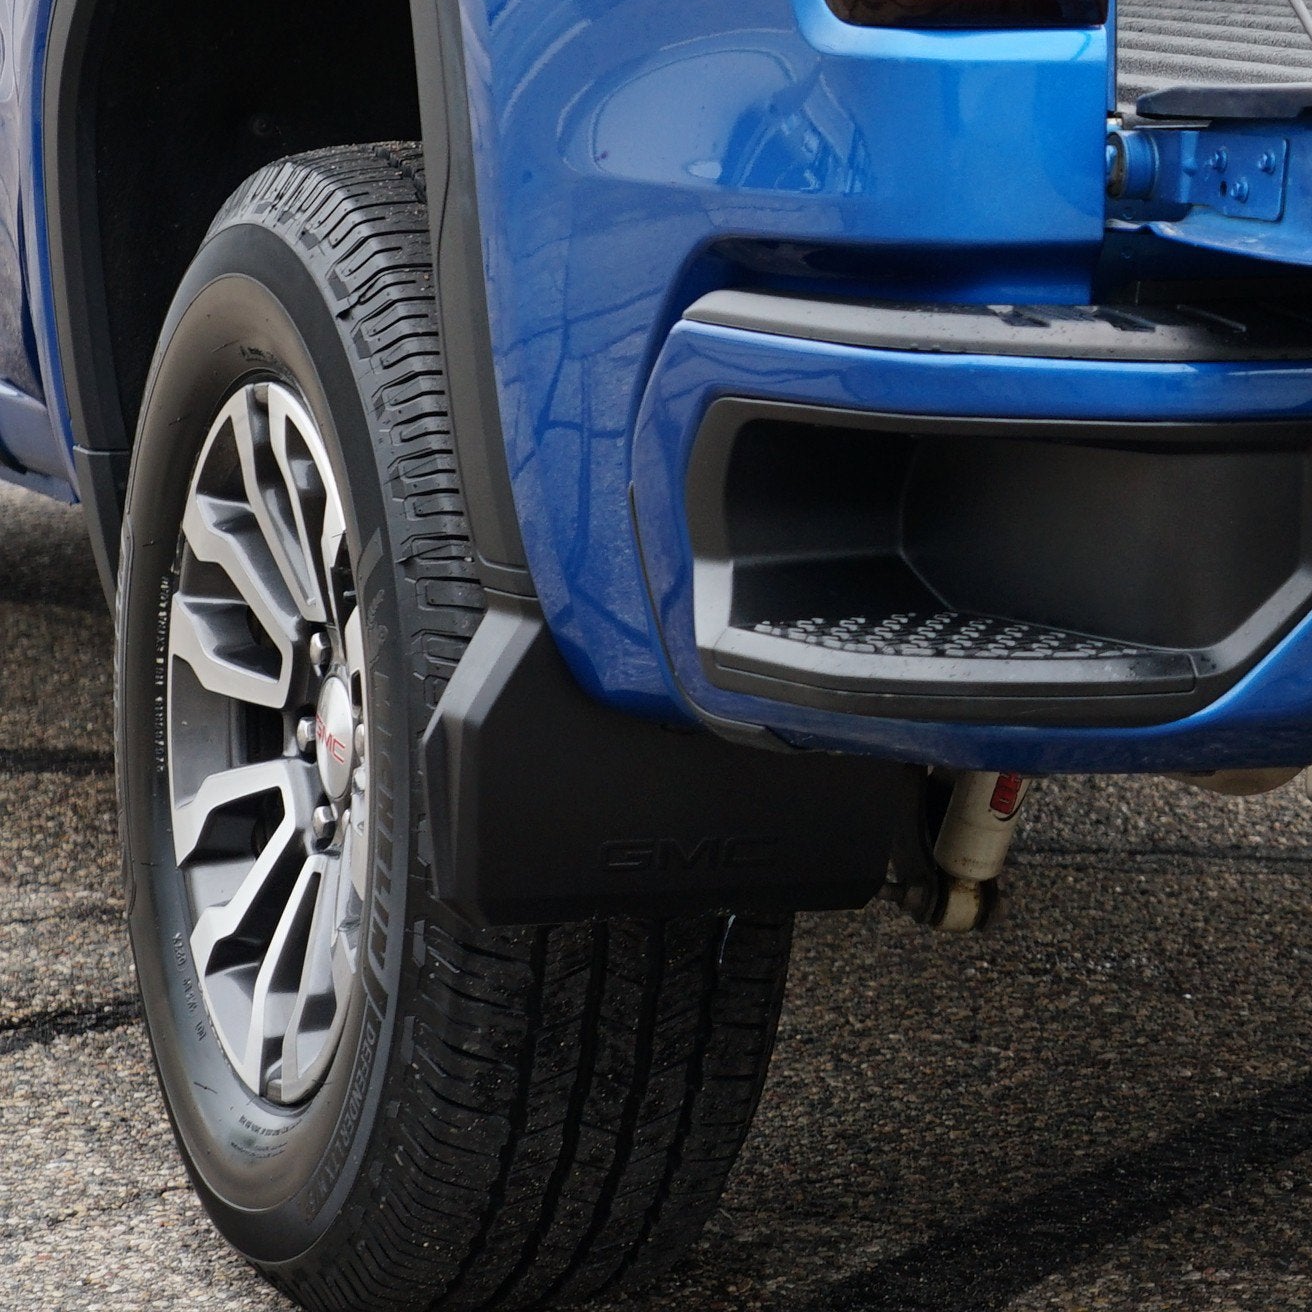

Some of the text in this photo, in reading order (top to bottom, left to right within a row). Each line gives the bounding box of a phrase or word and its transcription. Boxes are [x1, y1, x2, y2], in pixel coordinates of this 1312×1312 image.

[315, 715, 346, 765] GMC
[368, 670, 395, 971] MICHELIN
[600, 835, 780, 872] GMC
[338, 1022, 378, 1147] DEFENDER
